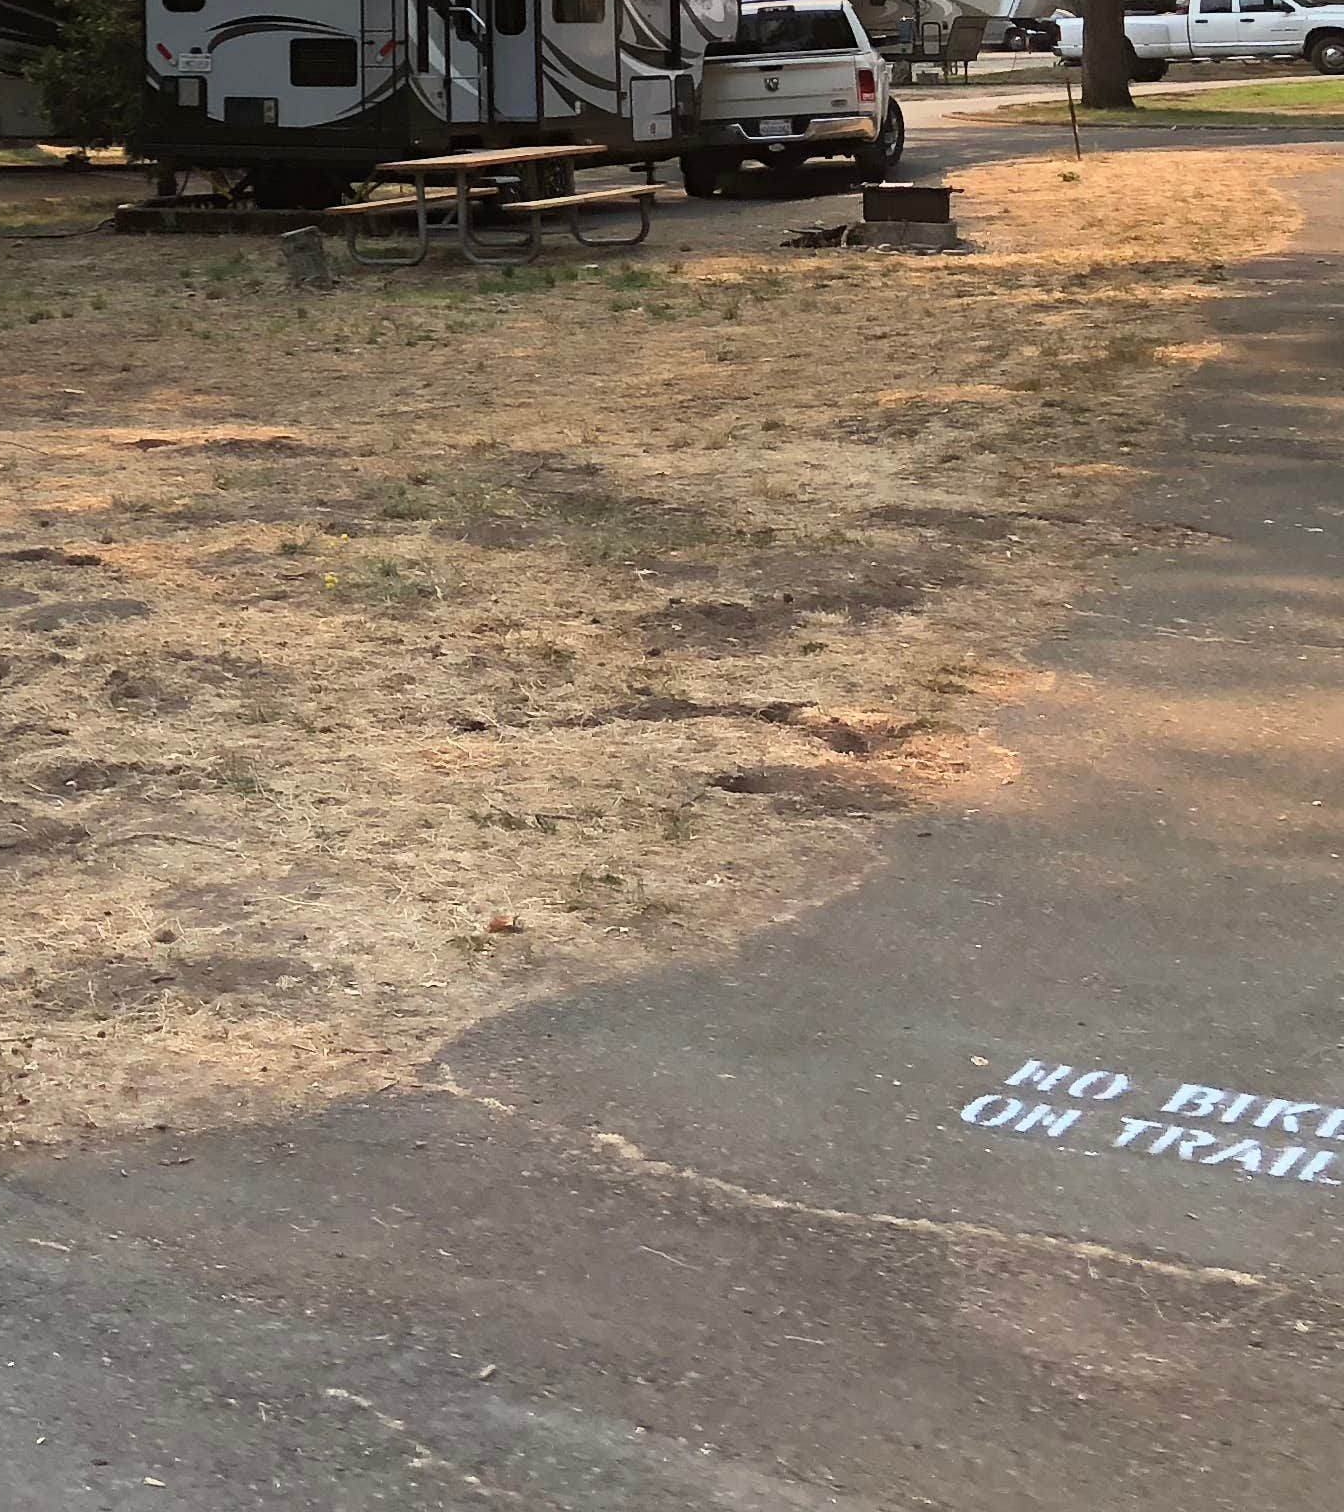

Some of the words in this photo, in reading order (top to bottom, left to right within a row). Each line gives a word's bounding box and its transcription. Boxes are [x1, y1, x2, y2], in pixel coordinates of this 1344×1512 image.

[1004, 1059, 1131, 1100] NO
[960, 1094, 1082, 1137] ON
[1113, 1115, 1342, 1186] TRAIL
